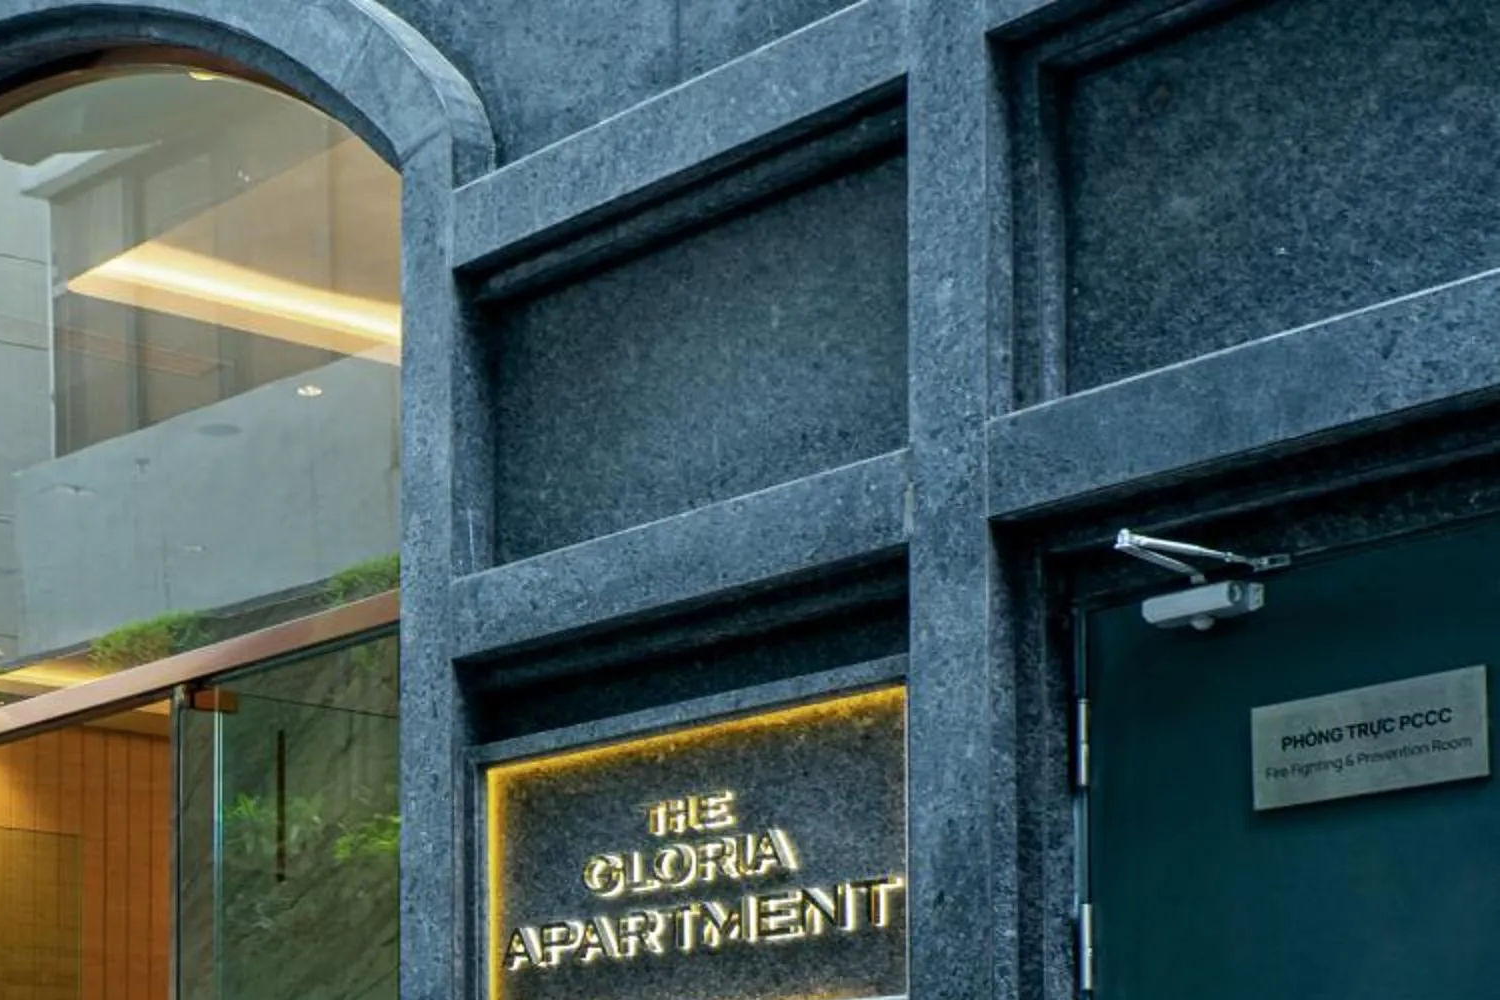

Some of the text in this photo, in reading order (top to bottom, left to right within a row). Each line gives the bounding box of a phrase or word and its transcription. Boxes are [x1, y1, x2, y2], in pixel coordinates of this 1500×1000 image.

[1281, 725, 1343, 752] PHÒNG
[1399, 707, 1453, 731] PCCC
[1345, 753, 1355, 767] &
[1431, 736, 1473, 753] Room
[645, 790, 737, 836] THE
[583, 828, 798, 897] GLORIA
[502, 876, 905, 971] APARTMENT
